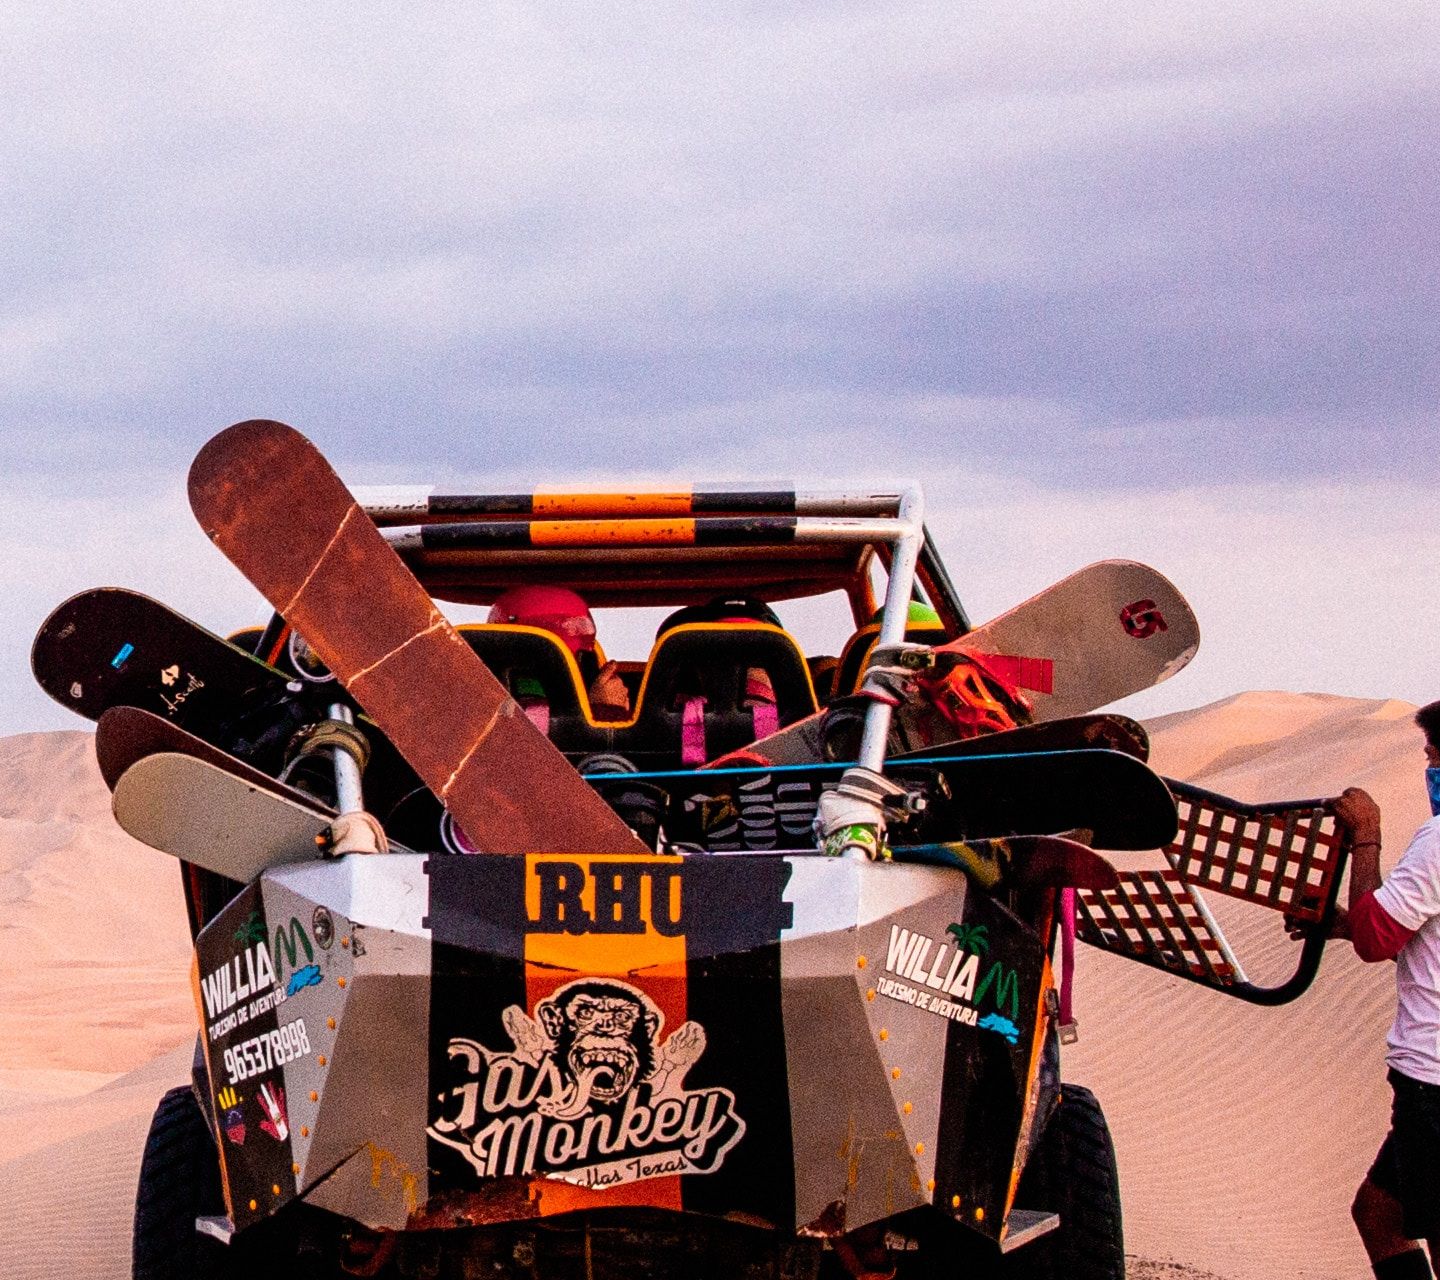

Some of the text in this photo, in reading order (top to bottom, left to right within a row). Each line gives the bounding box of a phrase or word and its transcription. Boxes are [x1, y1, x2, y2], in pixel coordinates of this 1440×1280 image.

[208, 1013, 238, 1041] TURISMO
[236, 1006, 249, 1025] DE
[877, 977, 978, 1027] TURISMO DE AVENTURA
[223, 1018, 312, 1084] 965378998
[473, 1083, 727, 1177] Monkey
[625, 1157, 688, 1179] Texas
